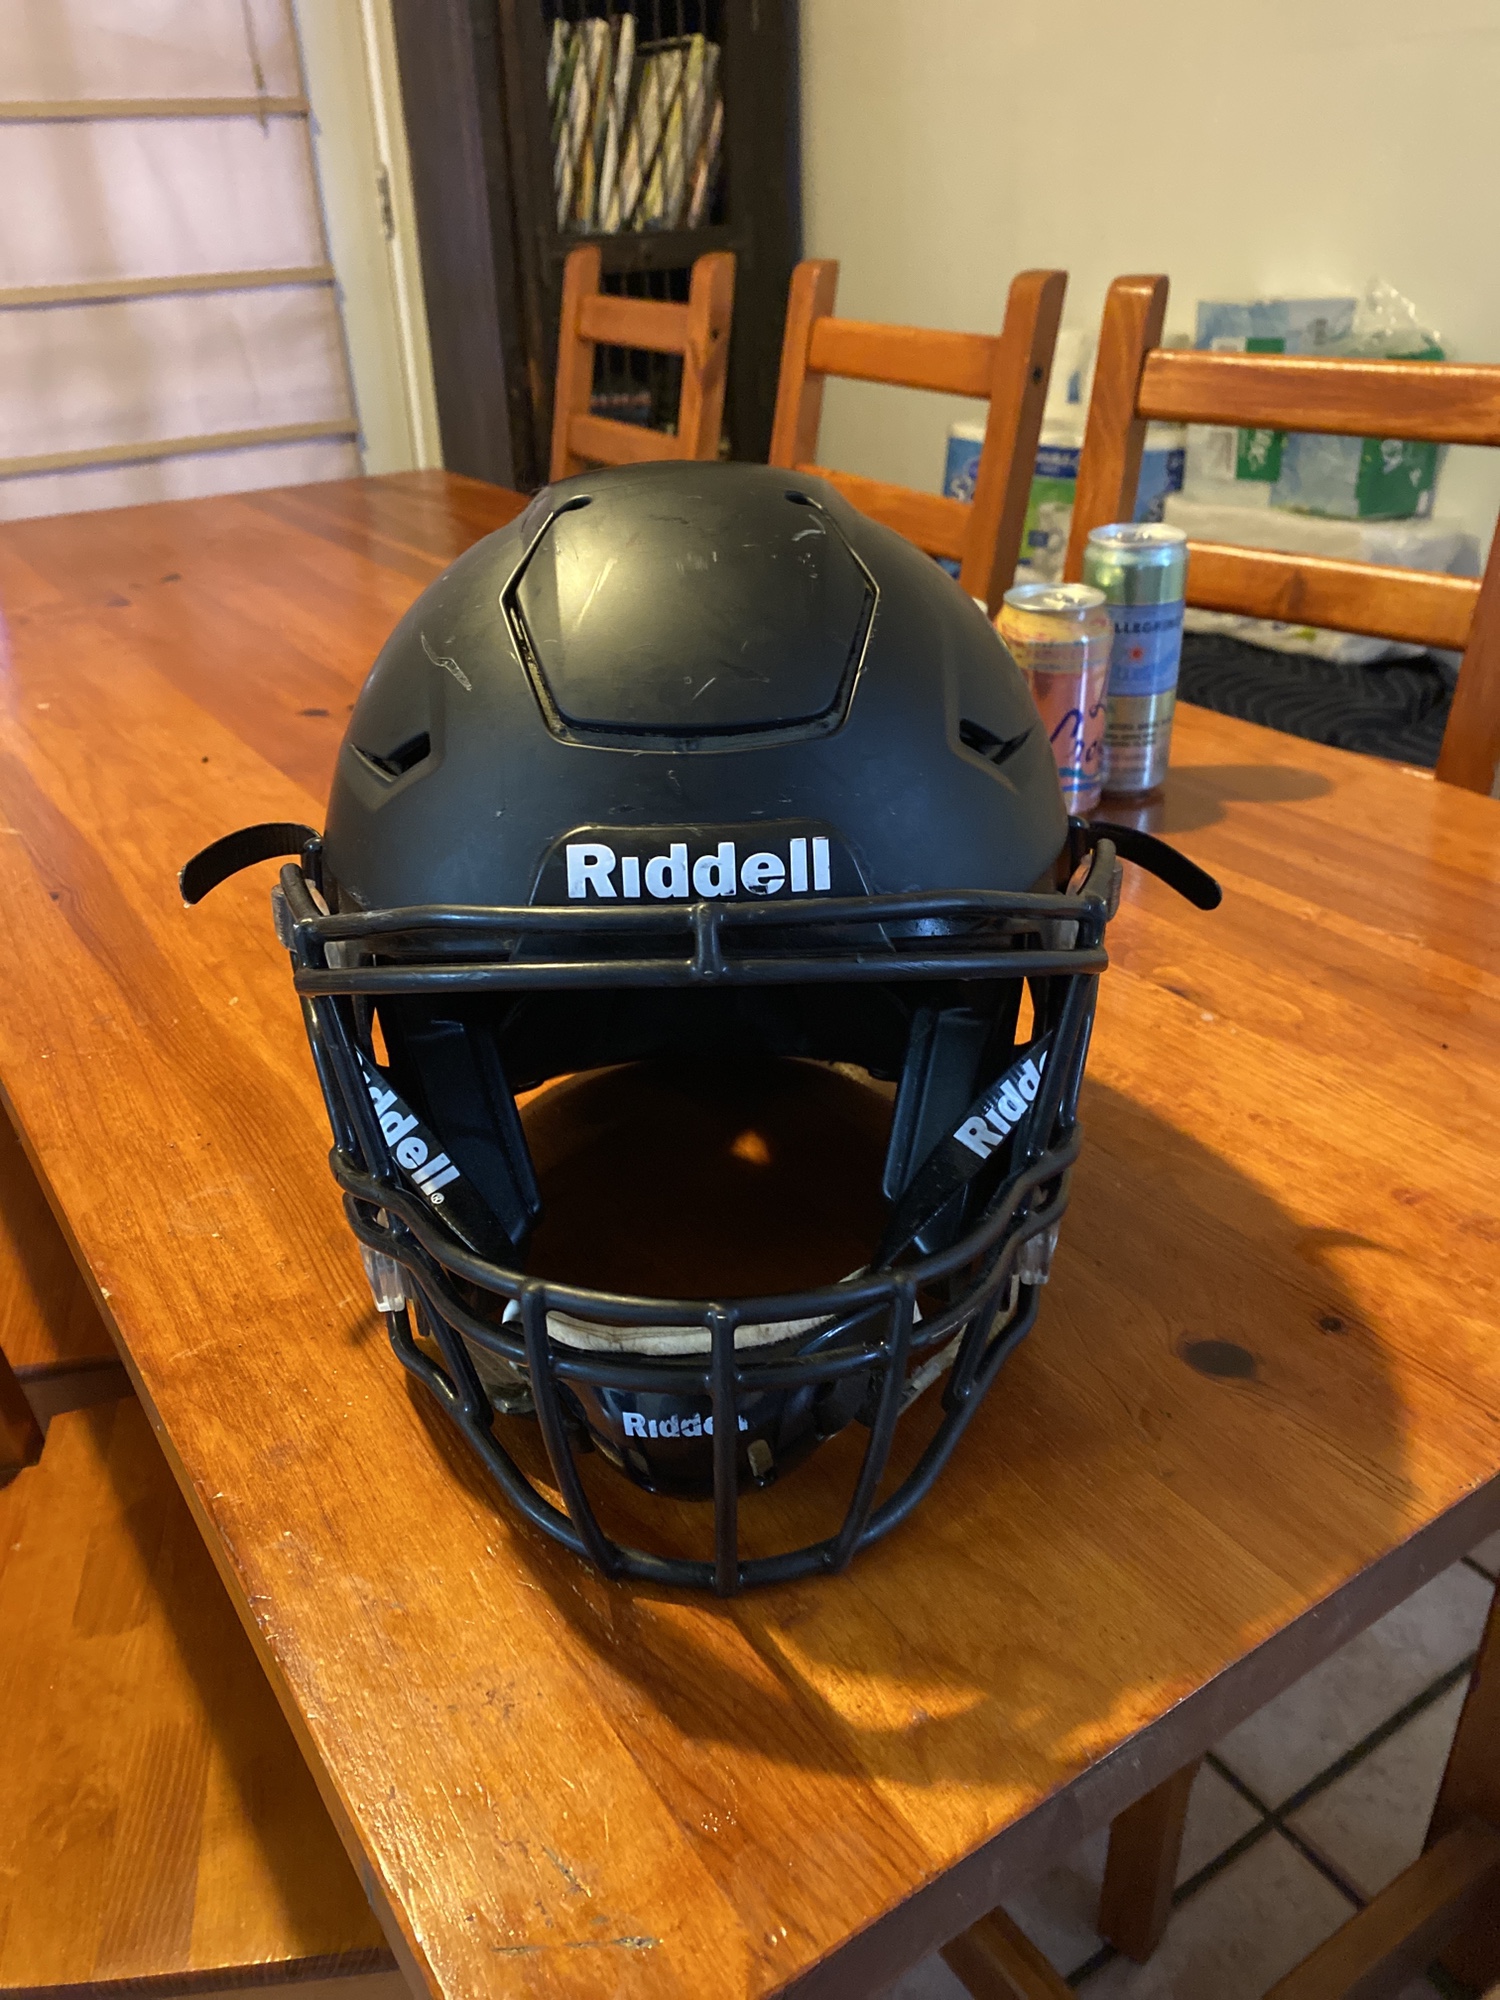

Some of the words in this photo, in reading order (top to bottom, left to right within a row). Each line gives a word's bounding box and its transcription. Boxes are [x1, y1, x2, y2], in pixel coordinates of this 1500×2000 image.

[566, 836, 831, 899] Riddell
[356, 1051, 461, 1197] ddell
[953, 1050, 1048, 1160] Ridd
